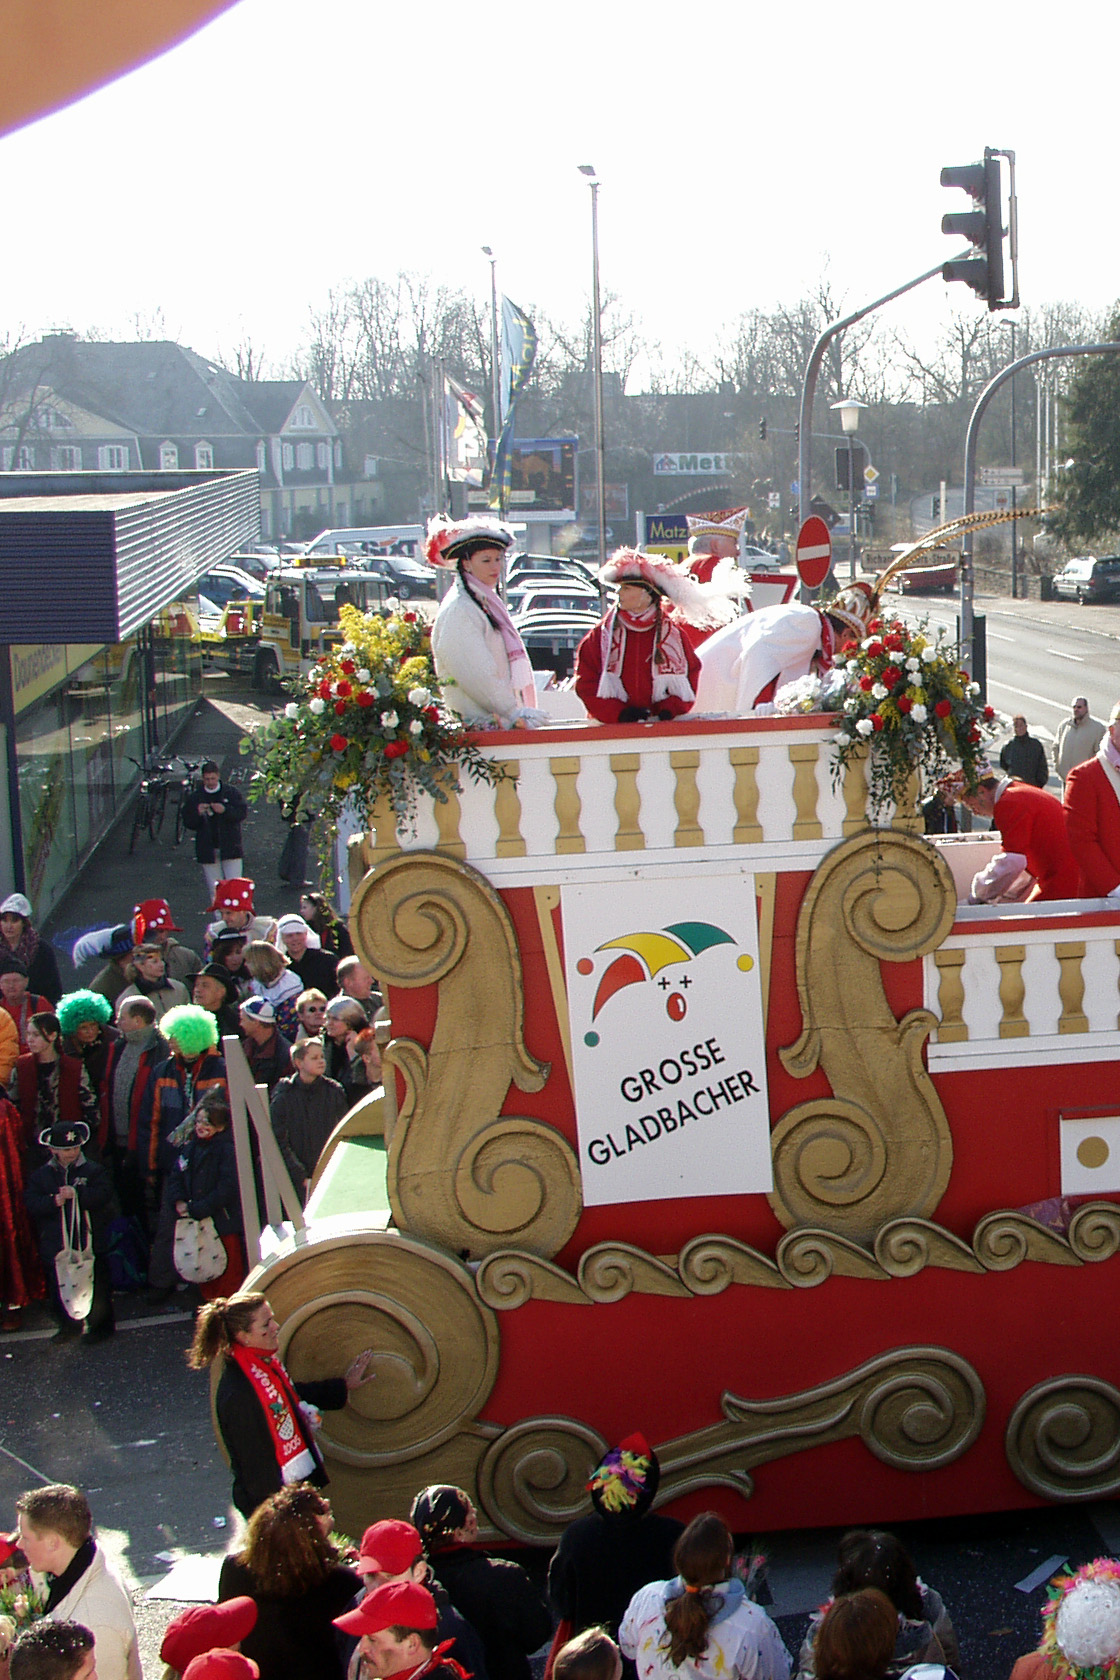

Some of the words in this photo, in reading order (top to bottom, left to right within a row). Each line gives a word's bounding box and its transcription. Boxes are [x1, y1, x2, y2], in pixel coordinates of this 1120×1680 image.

[650, 521, 690, 539] Matz
[620, 1037, 725, 1102] GROSSE
[588, 1070, 760, 1165] GLADBACHER
